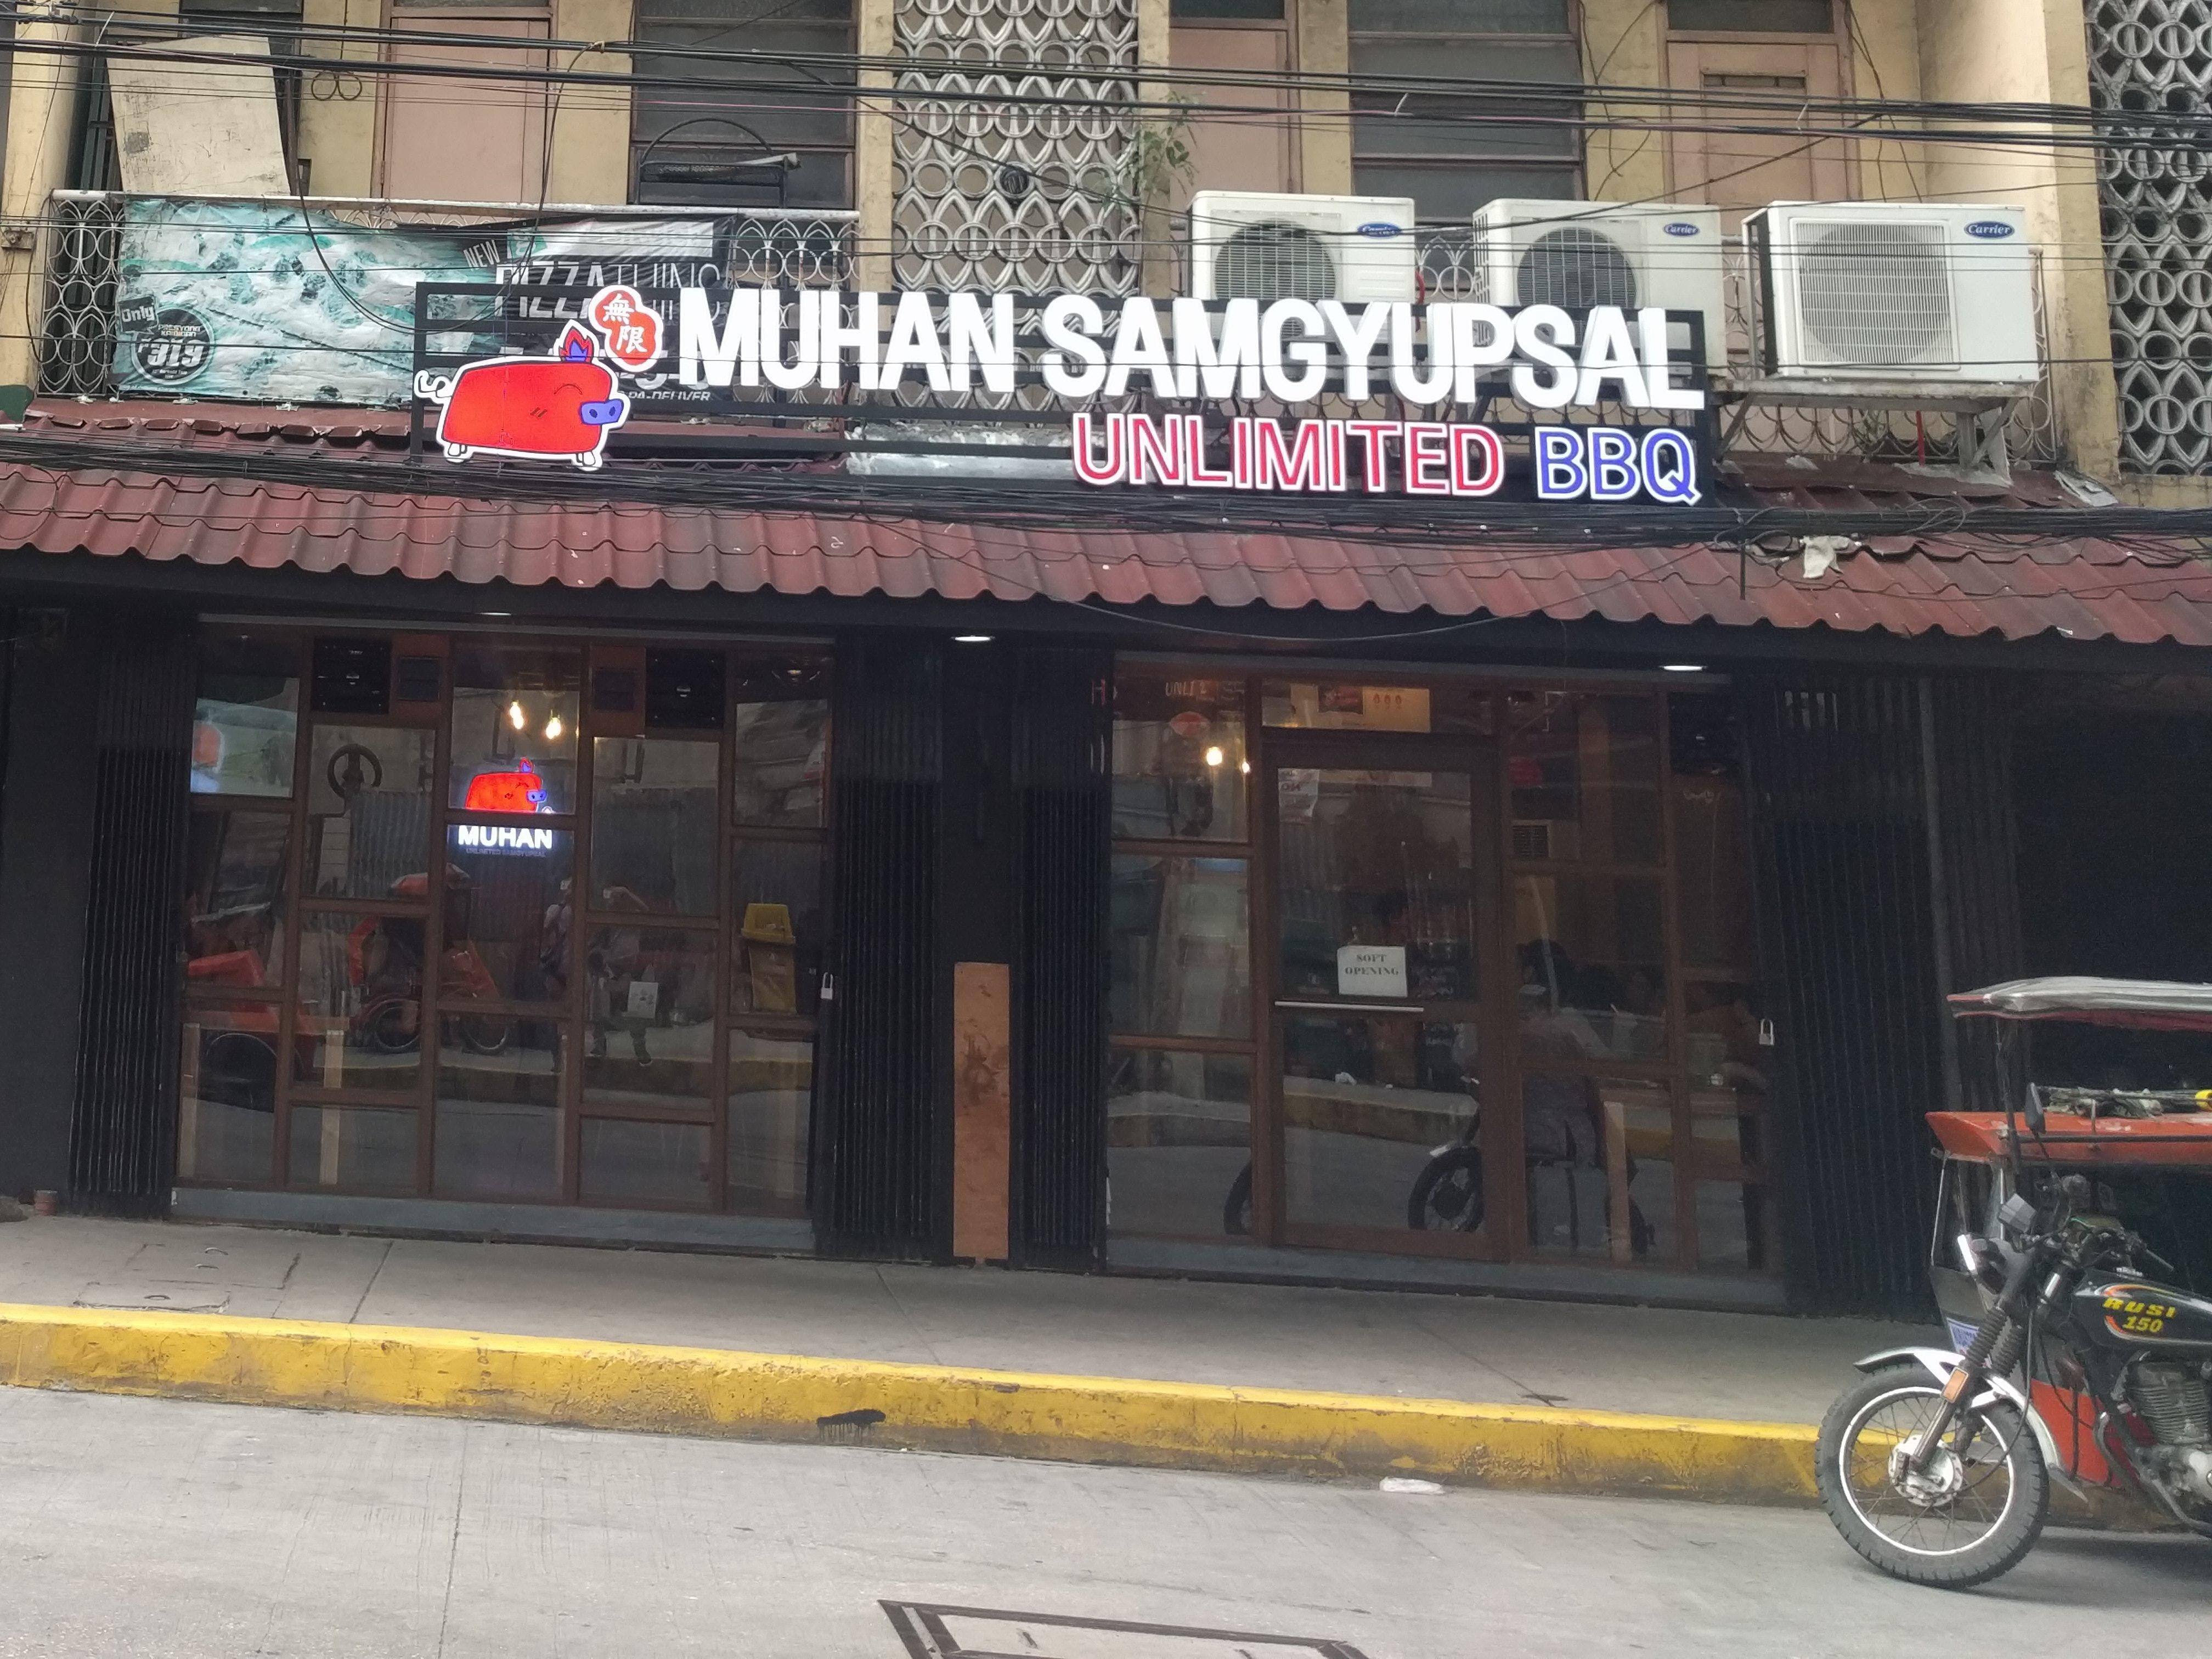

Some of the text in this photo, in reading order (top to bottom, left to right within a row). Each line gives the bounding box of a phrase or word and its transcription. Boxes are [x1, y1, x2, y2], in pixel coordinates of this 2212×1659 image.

[1968, 224, 2011, 234] Carrier
[462, 240, 500, 270] NEW
[495, 261, 604, 319] PIZZA
[121, 306, 155, 323] Only
[602, 293, 647, 354] 無限
[679, 287, 1015, 393] MUHAN
[1041, 295, 1705, 411] SAMGYUPSAL
[1072, 412, 1702, 506] UNLIMITED BBQ
[458, 825, 552, 849] MUHAN
[1356, 953, 1387, 962] SOFT
[1345, 967, 1399, 975] OPENING
[2103, 1297, 2176, 1319] RUSI
[2122, 1316, 2163, 1333] 150
